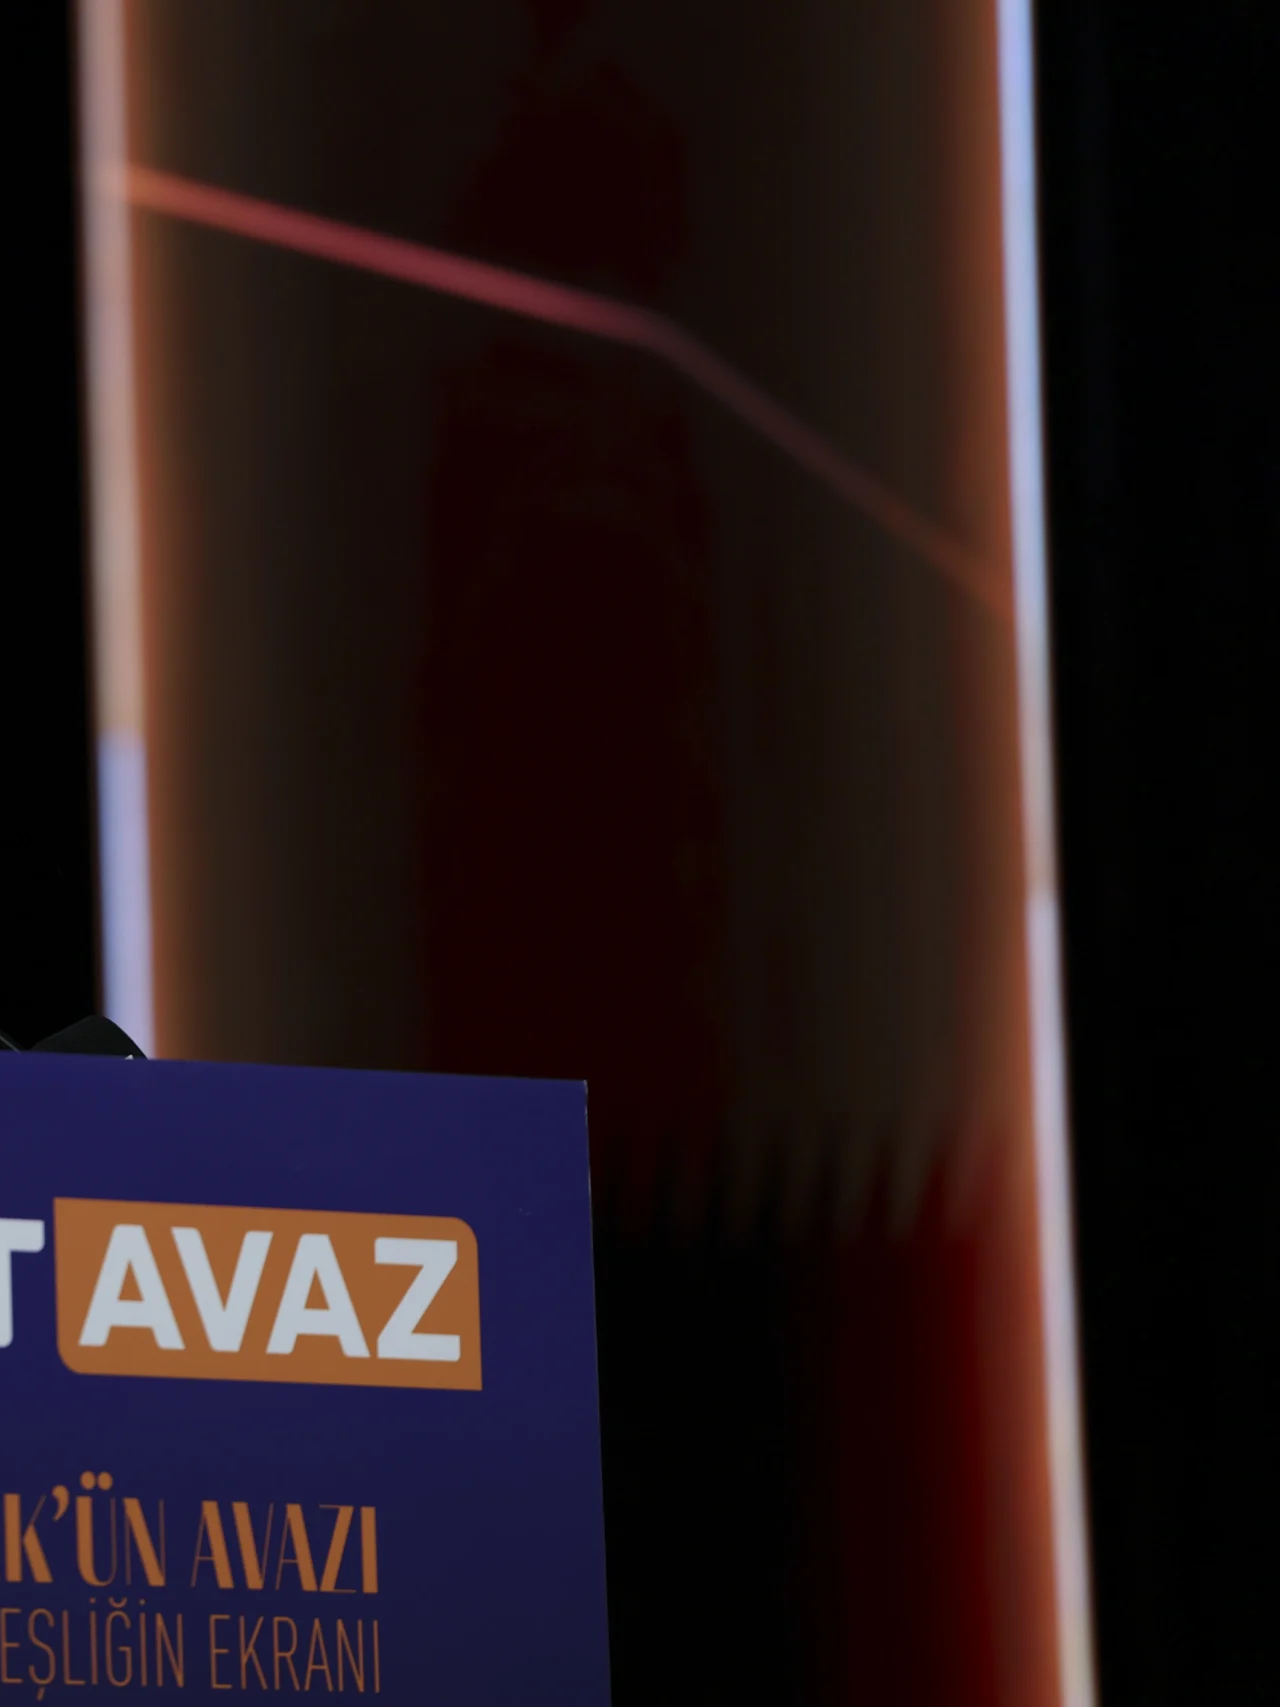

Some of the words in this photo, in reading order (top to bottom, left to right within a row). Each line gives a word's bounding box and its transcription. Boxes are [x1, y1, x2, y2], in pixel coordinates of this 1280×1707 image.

[79, 1224, 461, 1362] AVAZ
[191, 1500, 378, 1594] AVAZI
[210, 1614, 380, 1694] EKRANI
